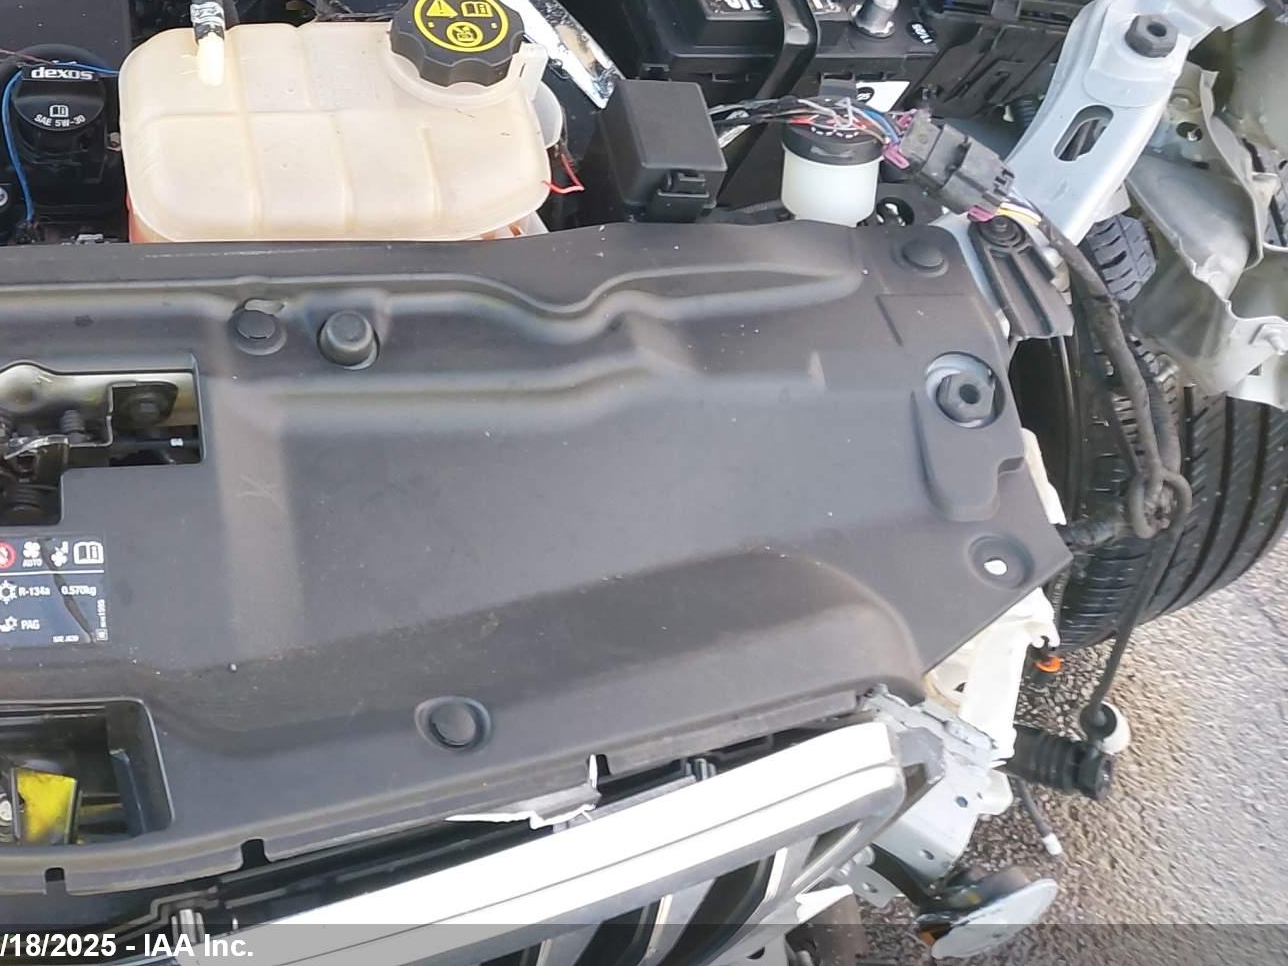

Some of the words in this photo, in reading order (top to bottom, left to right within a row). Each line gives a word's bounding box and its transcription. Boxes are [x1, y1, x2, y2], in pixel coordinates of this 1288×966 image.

[31, 66, 95, 80] dexos
[34, 114, 52, 127] SAE
[55, 114, 86, 127] 5W-30
[20, 619, 40, 630] PAG
